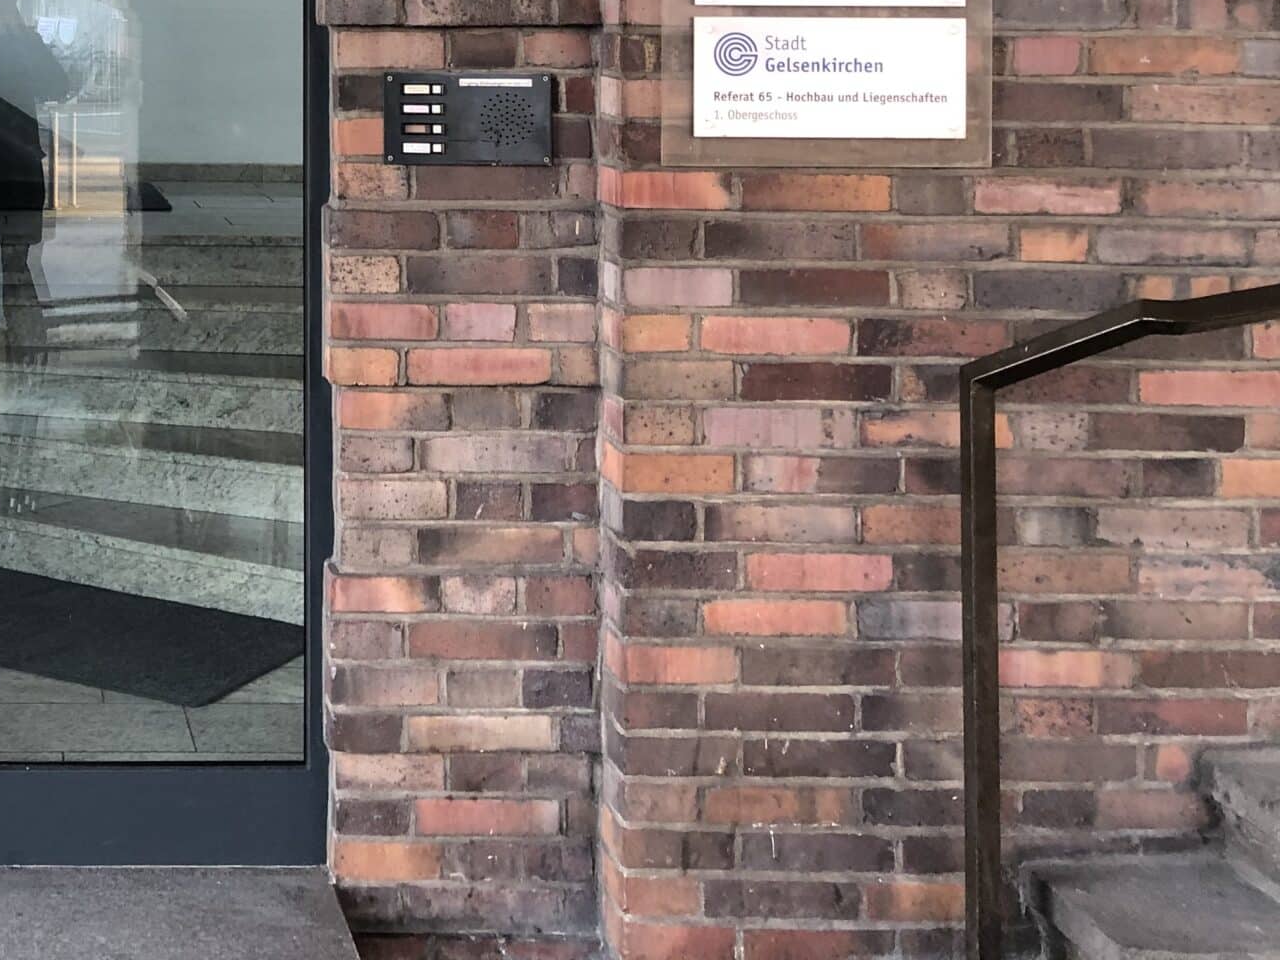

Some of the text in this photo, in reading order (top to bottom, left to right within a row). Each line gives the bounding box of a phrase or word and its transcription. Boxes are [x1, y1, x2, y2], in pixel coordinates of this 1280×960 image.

[765, 34, 807, 51] Stadt
[765, 57, 884, 73] Gelsenkirchen
[713, 91, 755, 102] Referat
[758, 91, 773, 102] 65
[786, 92, 834, 103] Hochbau
[837, 92, 859, 103] und
[862, 92, 948, 104] Liegenschaften
[727, 109, 798, 121] Obergeschoss
